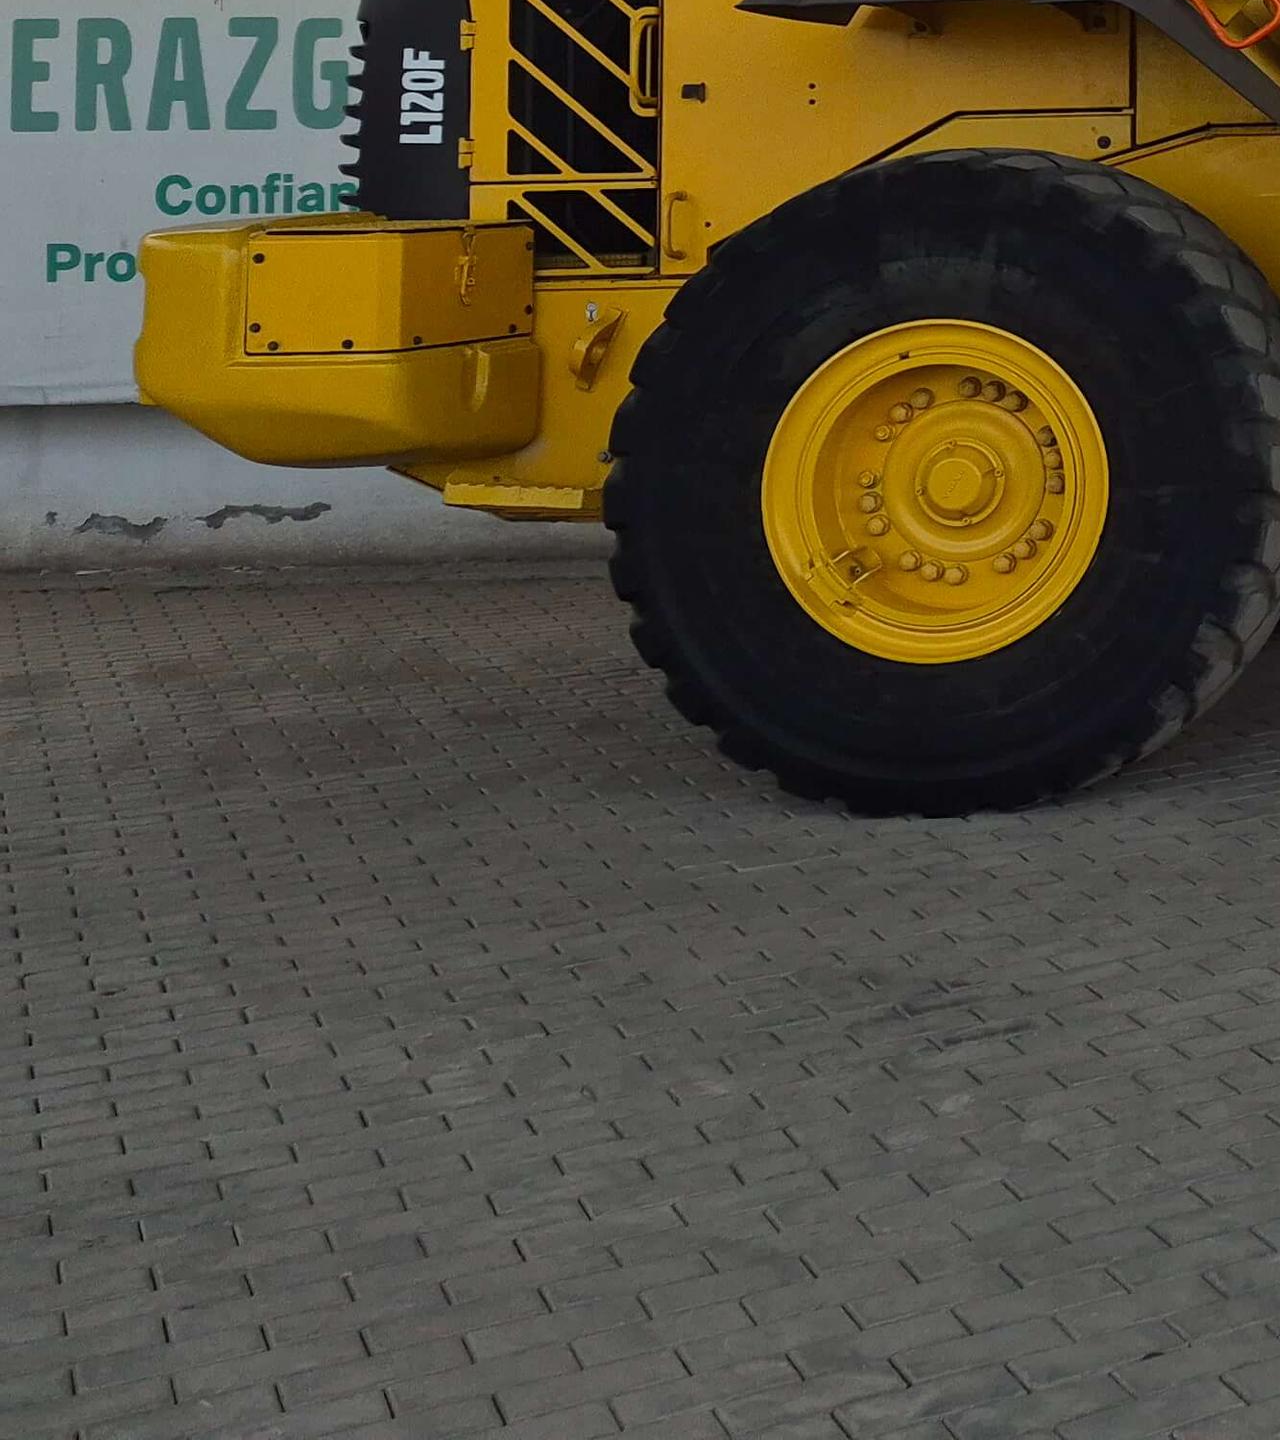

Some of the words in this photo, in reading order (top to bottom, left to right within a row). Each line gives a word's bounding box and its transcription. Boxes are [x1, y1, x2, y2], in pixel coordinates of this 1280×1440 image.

[10, 16, 349, 133] ERAZG
[399, 47, 445, 145] L120F
[46, 243, 137, 283] Pro
